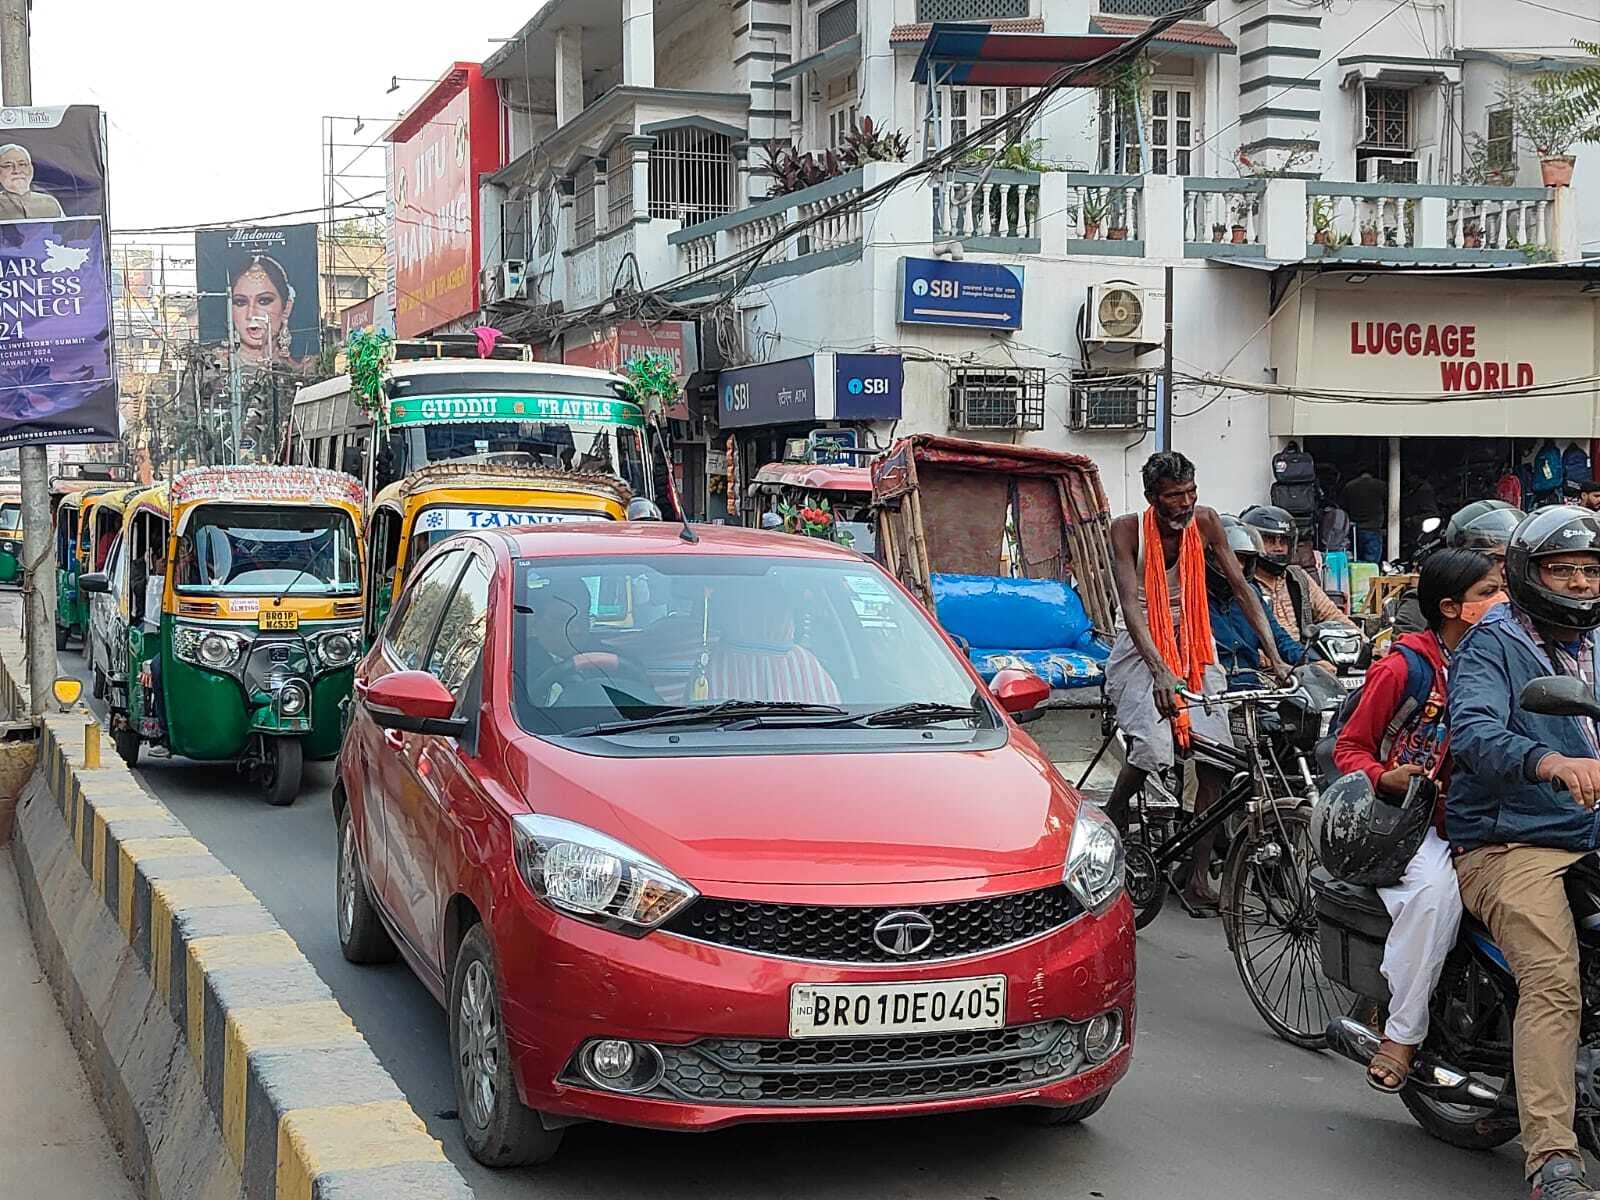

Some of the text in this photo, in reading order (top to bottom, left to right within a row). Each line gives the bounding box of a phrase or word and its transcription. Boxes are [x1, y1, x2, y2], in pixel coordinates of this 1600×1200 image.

[227, 229, 284, 240] Madonna
[398, 217, 433, 271] HAIR
[0, 258, 38, 278] AR
[930, 280, 959, 299] SBI
[0, 297, 85, 320] NNECT
[55, 337, 86, 346] SUMMIT
[1351, 322, 1476, 358] LUGGAGE
[31, 357, 55, 365] PATNA
[631, 344, 682, 375] SOLONS
[864, 378, 889, 395] SBI
[1440, 361, 1534, 392] WORLD
[733, 383, 750, 411] SBI
[794, 388, 808, 403] ATM
[421, 398, 612, 420] GUDDU TRAVELS
[266, 612, 294, 620] BR01P
[796, 986, 1001, 1027] IND BR01DE0405
